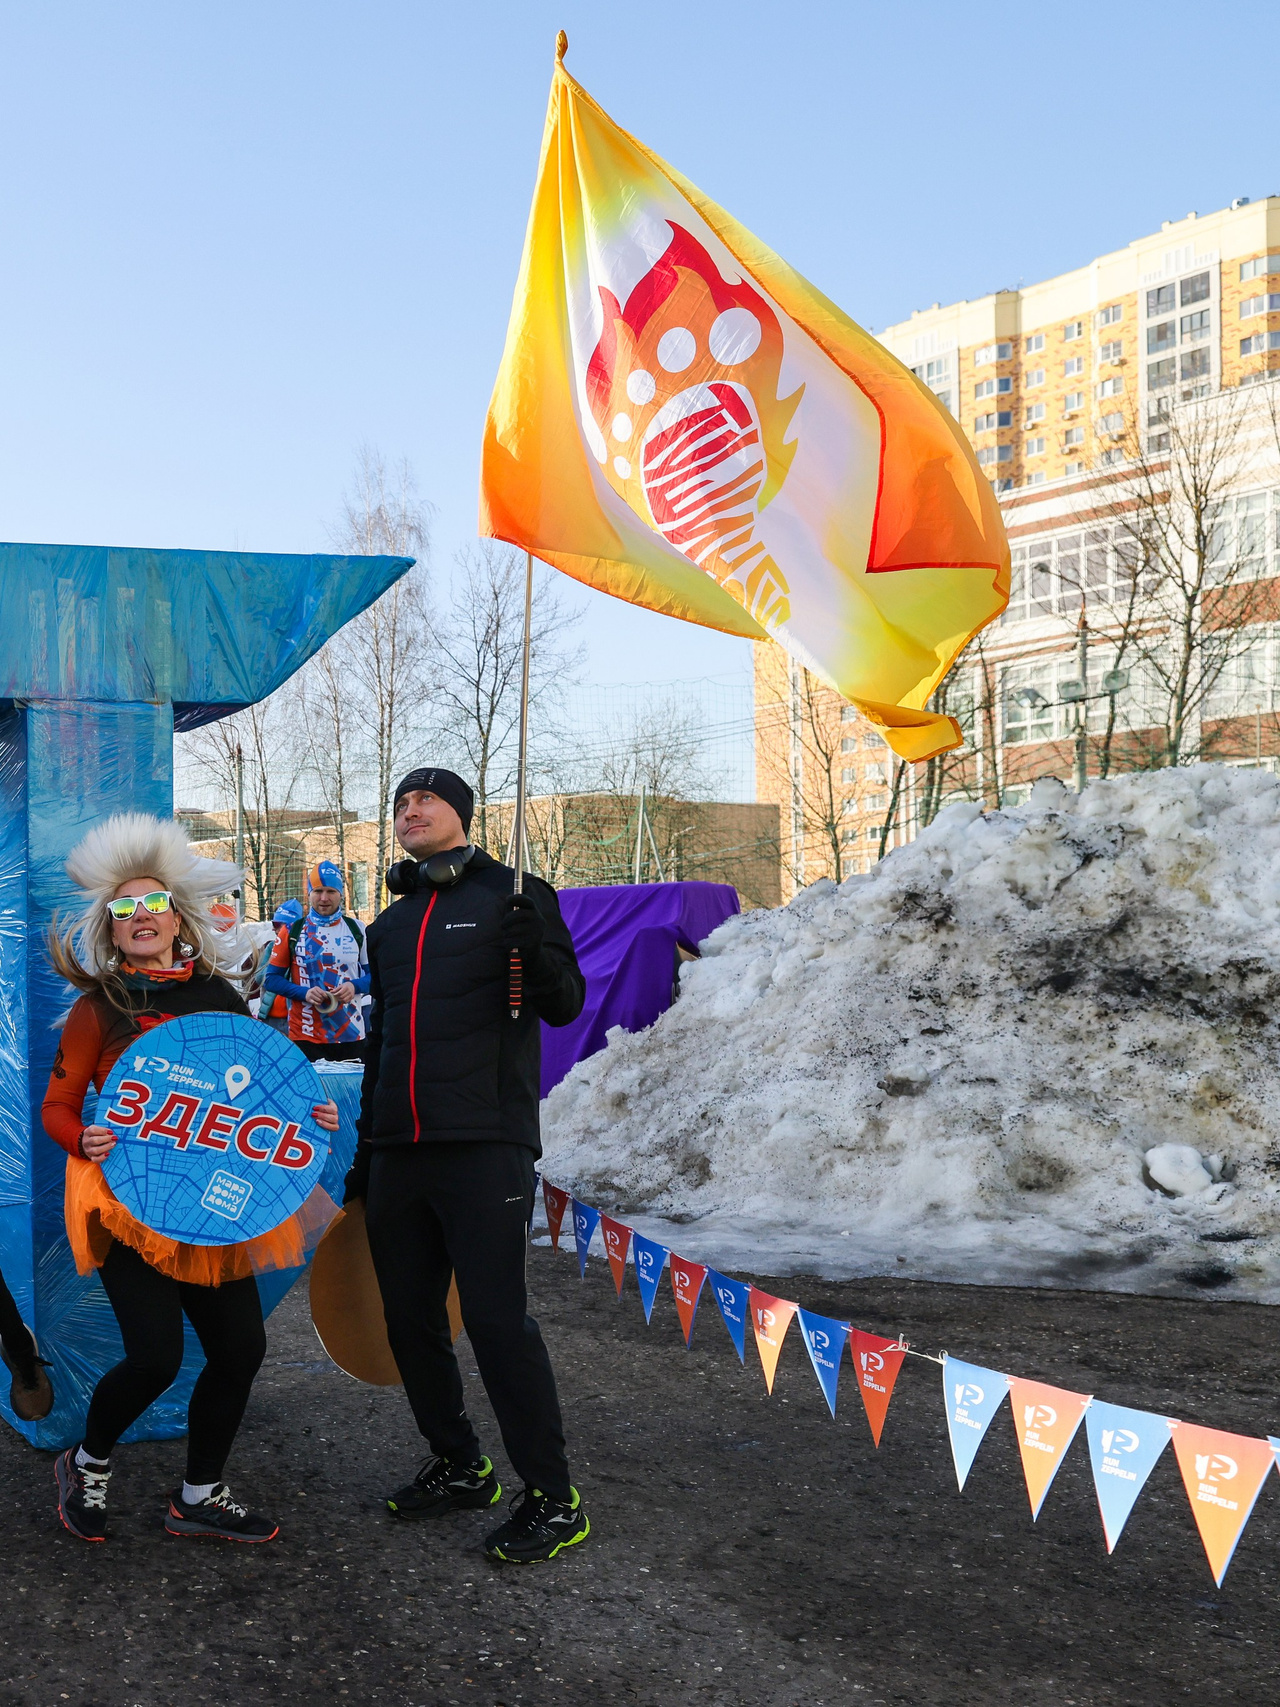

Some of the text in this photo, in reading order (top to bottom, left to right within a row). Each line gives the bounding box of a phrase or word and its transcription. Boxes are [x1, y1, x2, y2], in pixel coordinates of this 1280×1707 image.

[301, 1003, 315, 1037] RUN
[171, 1064, 194, 1076] RUN
[166, 1072, 216, 1092] ZEPPELIN
[104, 1079, 315, 1170] ЗДЕСЬ
[217, 1176, 246, 1195] мара
[212, 1185, 243, 1205] фону
[205, 1194, 238, 1213] дома
[864, 1374, 874, 1382] RUN
[863, 1380, 886, 1393] ZEPPELIN
[956, 1408, 968, 1418] RUN
[954, 1414, 982, 1430] ZEPPELIN
[1026, 1430, 1040, 1440] RUN
[1024, 1437, 1055, 1453] ZEPPELIN
[1103, 1456, 1120, 1467] RUN
[1101, 1464, 1137, 1481] ZEPPELIN
[1198, 1482, 1218, 1495] RUN
[1196, 1491, 1238, 1511] ZEPPELIN
